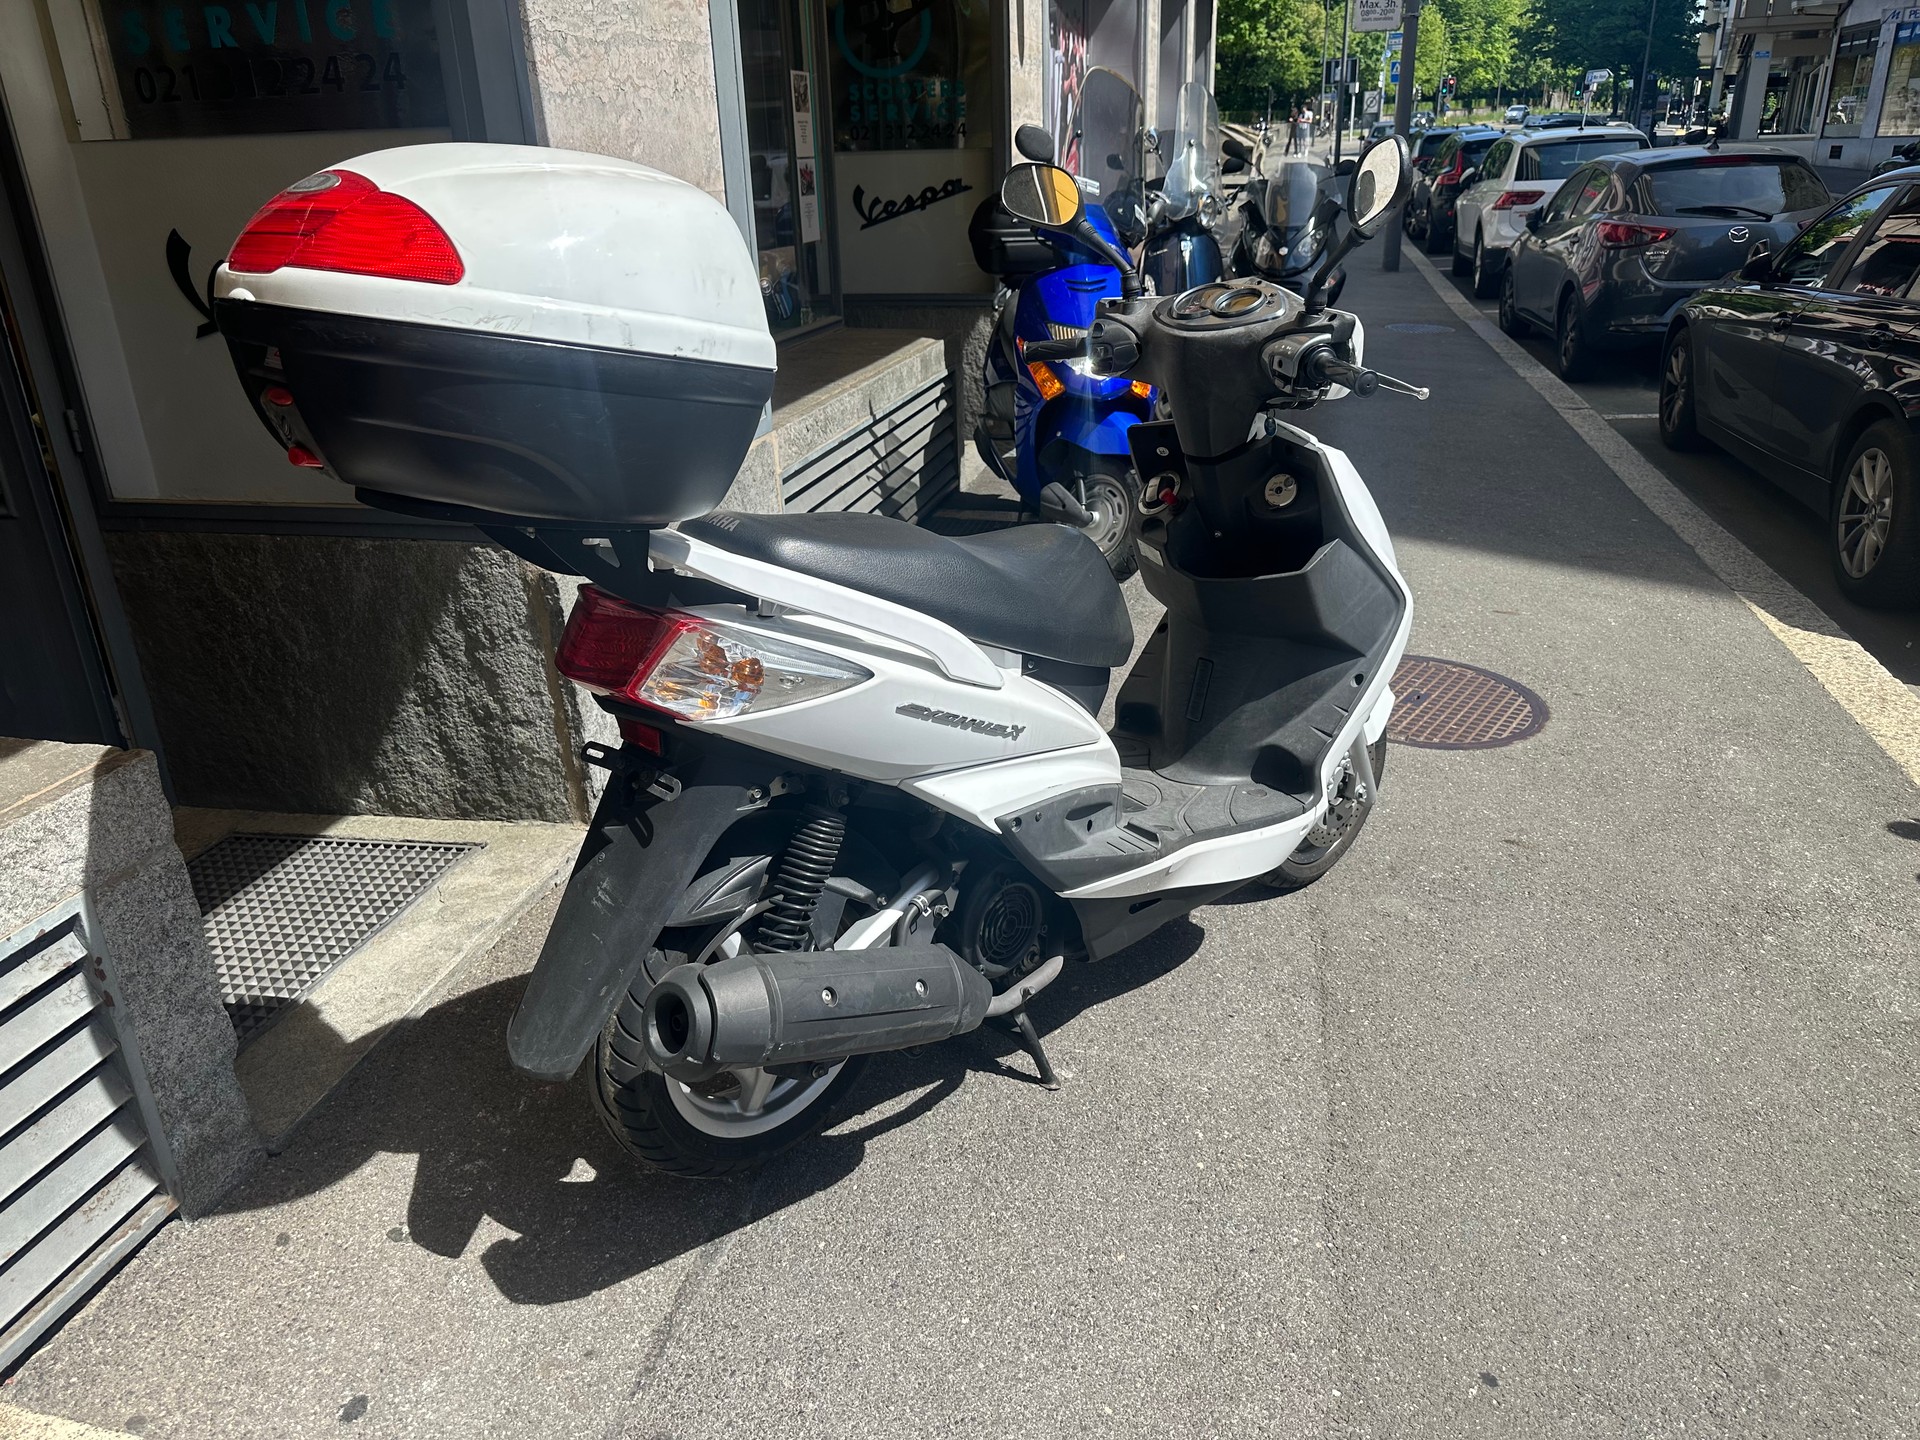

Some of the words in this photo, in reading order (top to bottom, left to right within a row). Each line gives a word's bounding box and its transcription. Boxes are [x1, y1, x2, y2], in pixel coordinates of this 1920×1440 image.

[1360, 0, 1382, 9] Max.
[1384, 0, 1399, 8] 3h.
[121, 0, 396, 56] SERVICE
[134, 64, 202, 104] 021
[293, 54, 346, 96] 24
[355, 51, 408, 92] 24
[849, 79, 966, 101] SCOOTERS
[850, 102, 966, 121] SERVICE
[850, 125, 880, 140] 021
[886, 124, 917, 140] 312
[922, 123, 941, 138] 24
[946, 122, 967, 138] 24
[853, 178, 973, 231] Vespa
